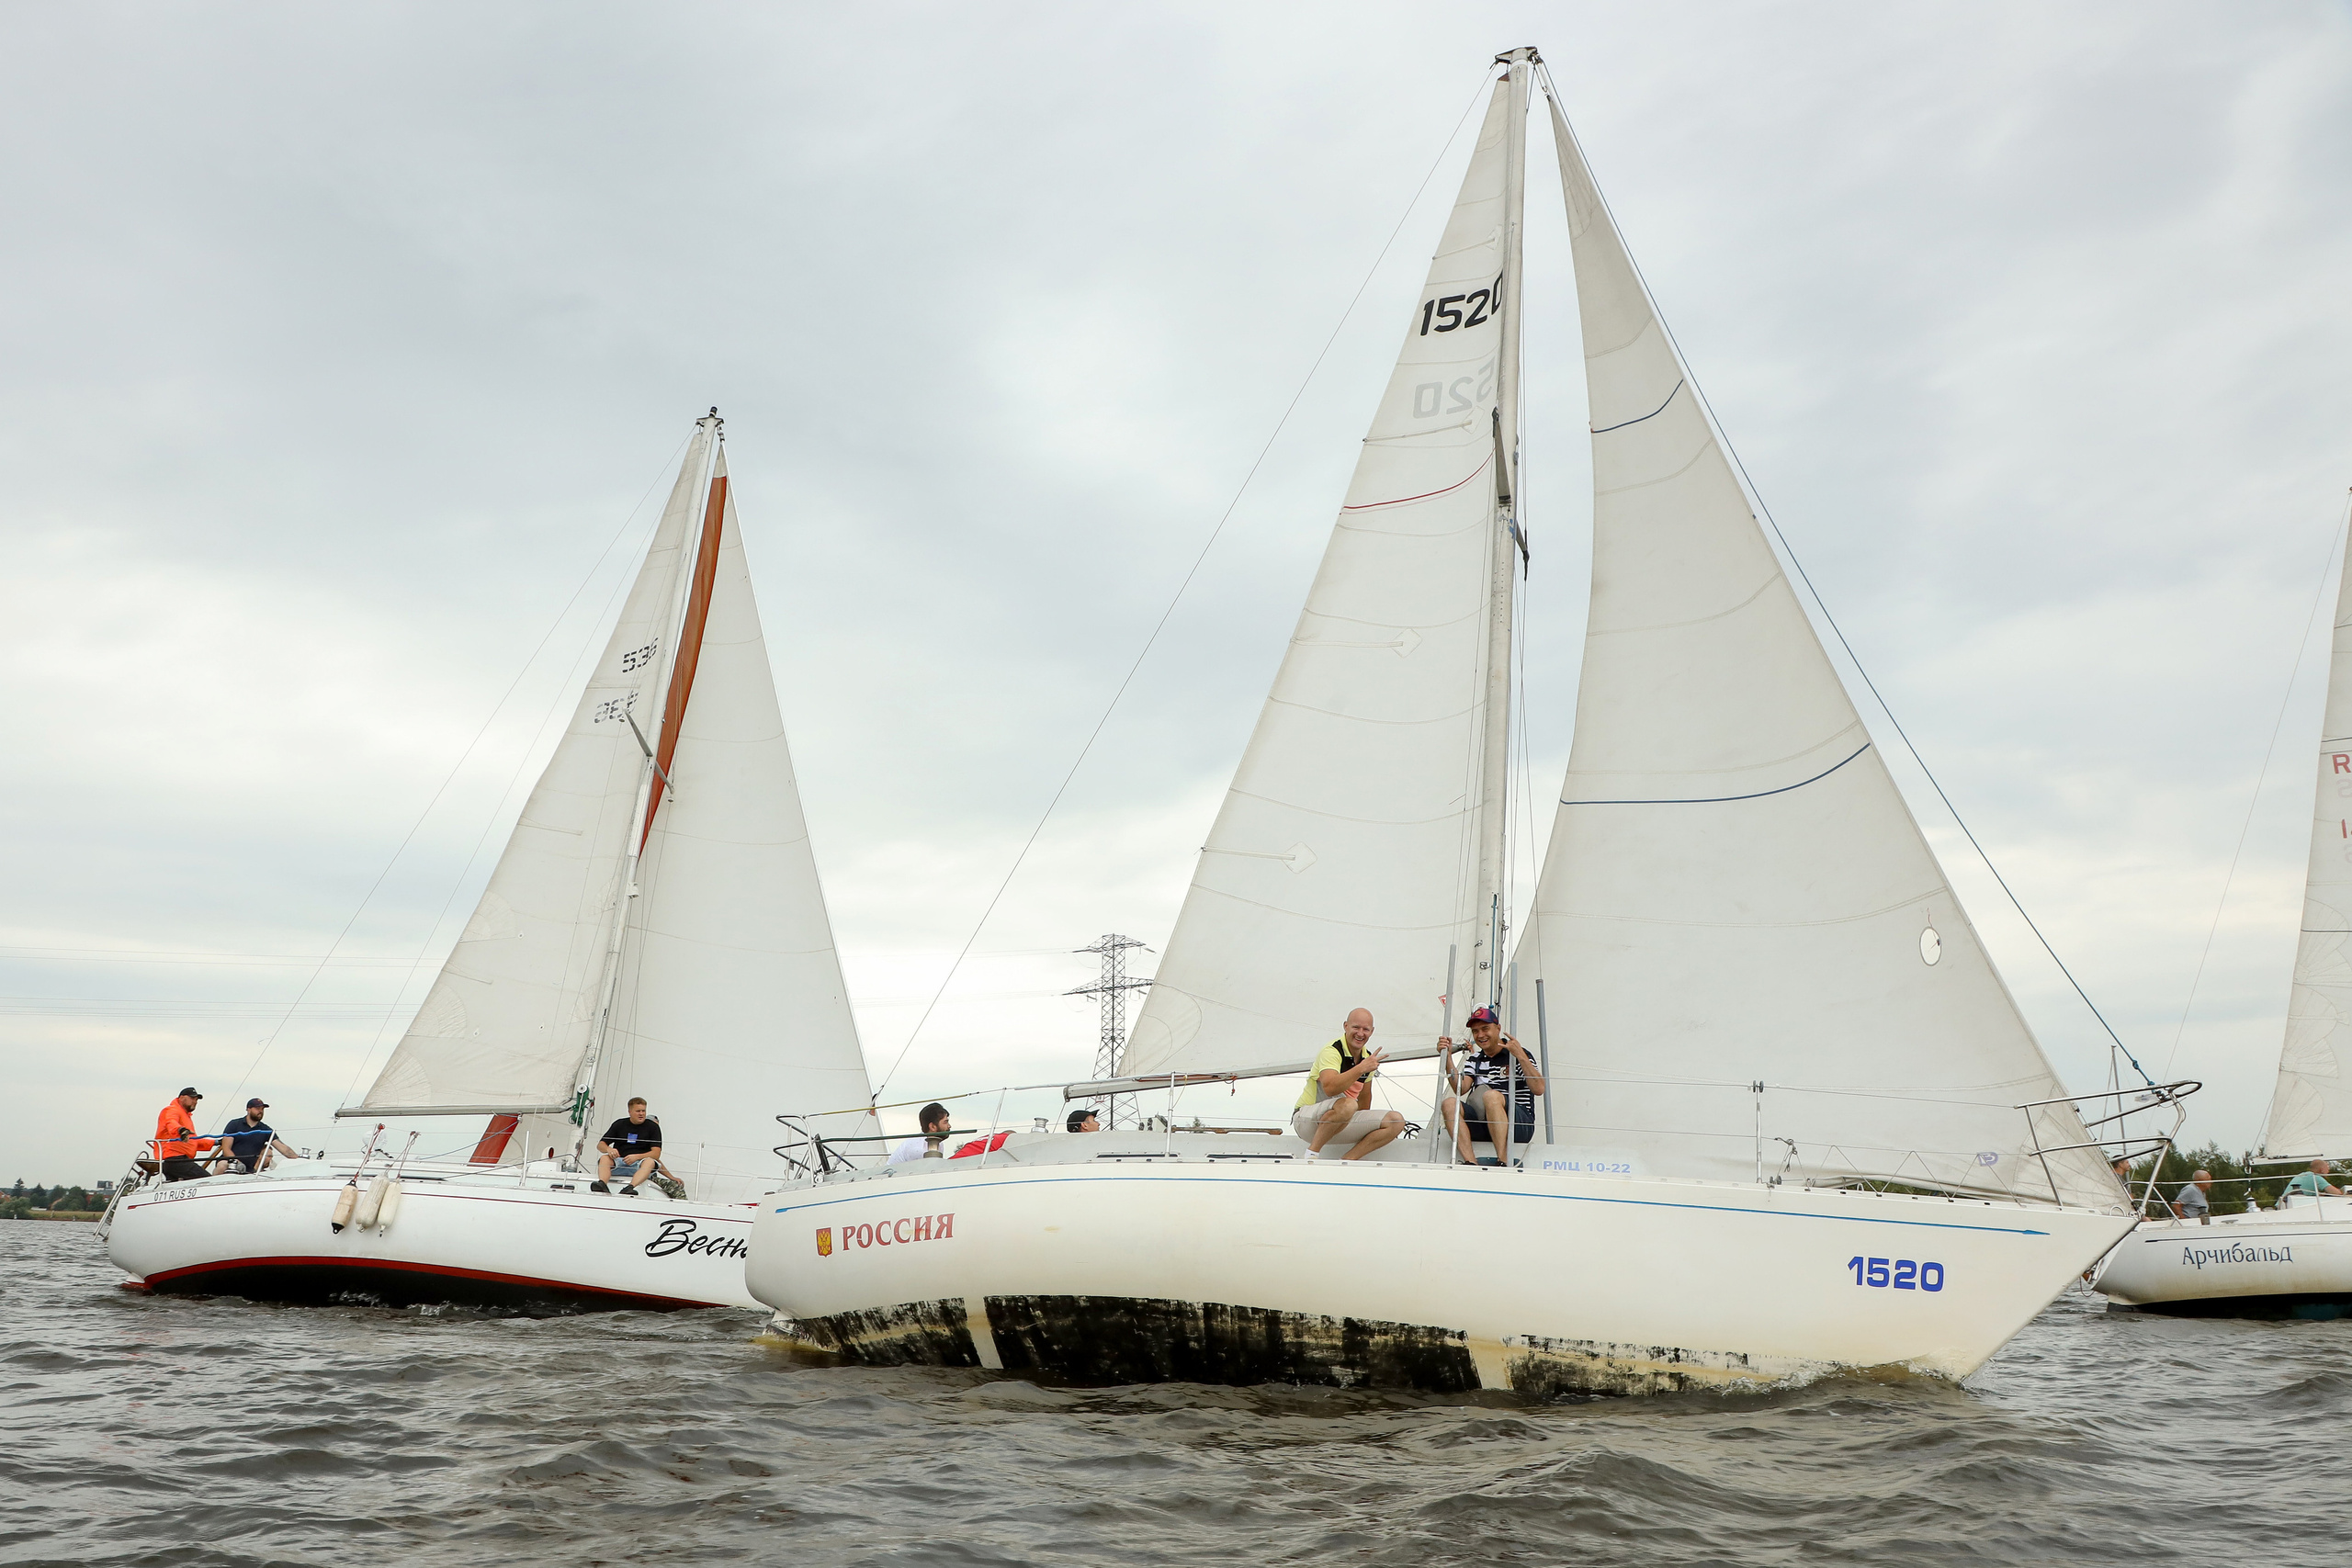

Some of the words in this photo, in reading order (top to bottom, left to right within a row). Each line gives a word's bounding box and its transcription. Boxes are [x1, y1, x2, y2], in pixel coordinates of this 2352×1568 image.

[1420, 270, 1504, 336] 1520
[1543, 1160, 1580, 1171] РМЦ
[1586, 1162, 1631, 1174] 10-22
[153, 1191, 168, 1201] 071
[168, 1189, 187, 1201] RUS
[187, 1188, 198, 1198] 50
[842, 1213, 956, 1251] РОССИЯ
[2182, 1242, 2294, 1270] Арчибальд
[1847, 1256, 1945, 1292] 1520
